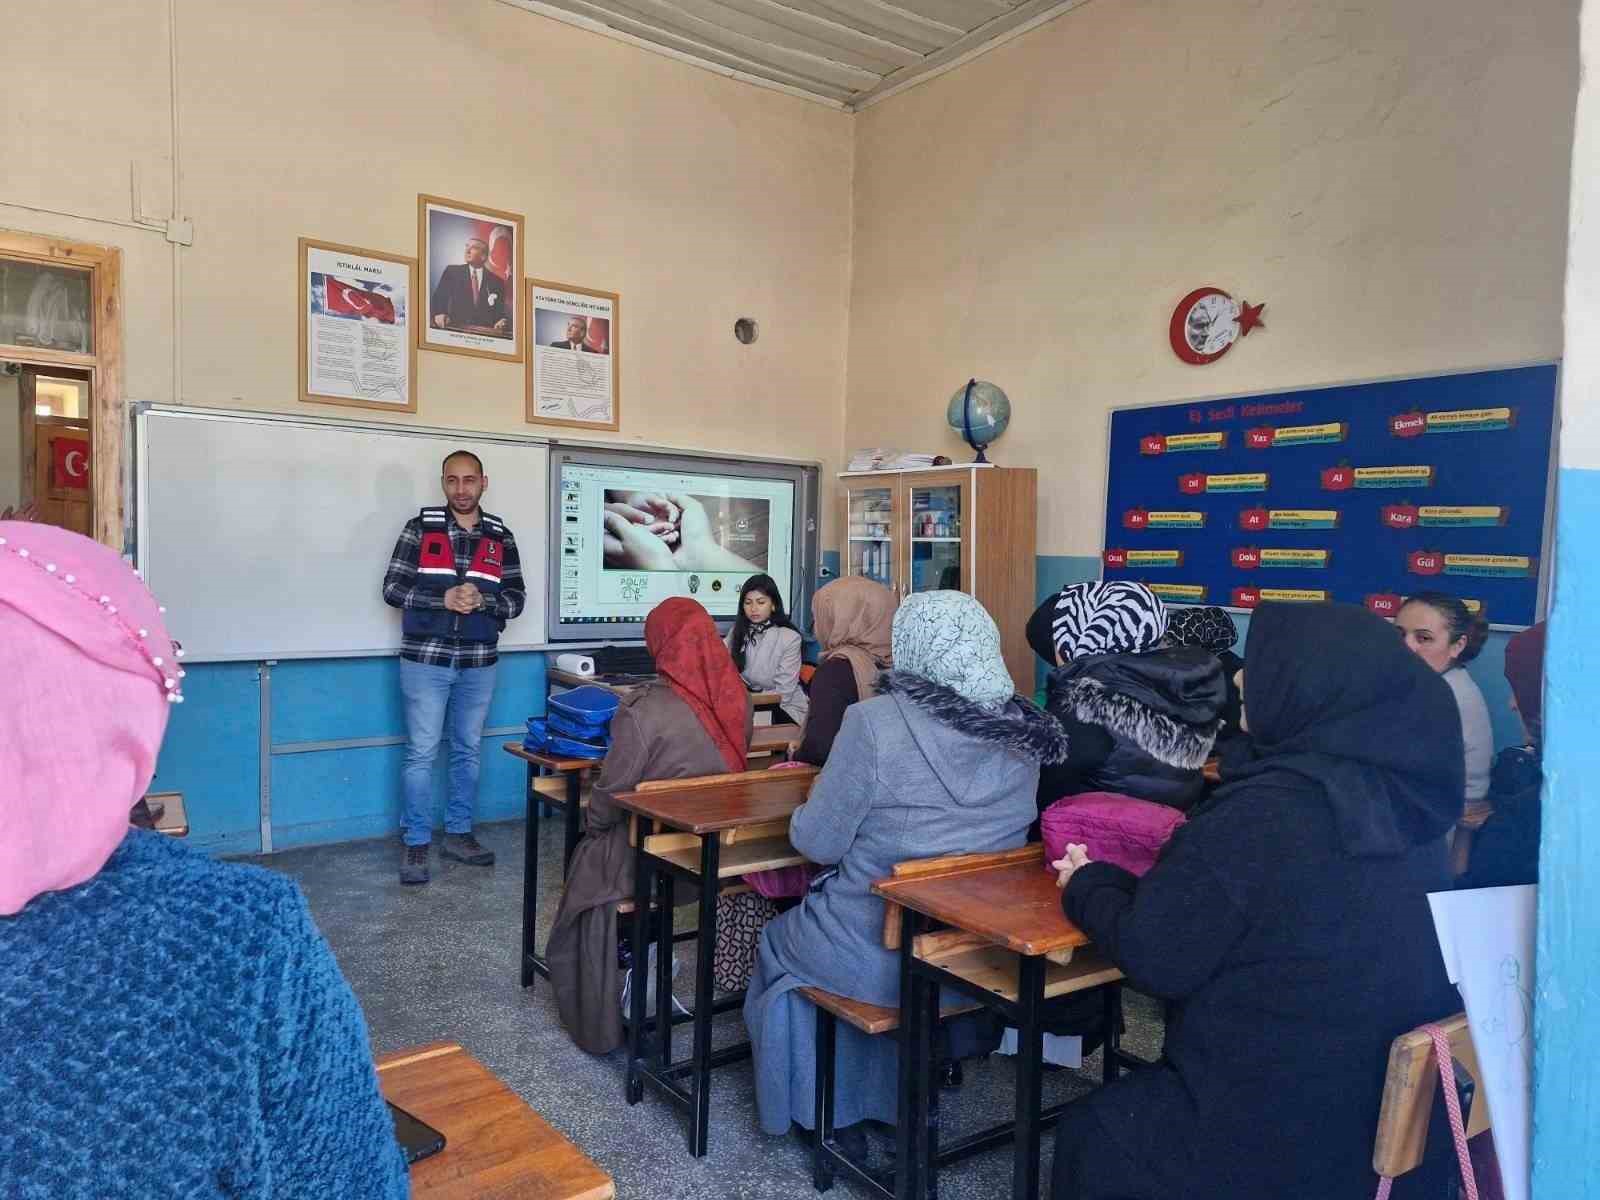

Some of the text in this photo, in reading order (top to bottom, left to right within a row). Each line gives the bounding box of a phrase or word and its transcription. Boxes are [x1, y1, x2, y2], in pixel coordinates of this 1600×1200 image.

[1394, 418, 1424, 429] Ekmek
[1252, 434, 1267, 442] Yaz
[1390, 512, 1412, 523] Kara
[1239, 553, 1257, 561] Dolu
[1416, 557, 1435, 567] Gül
